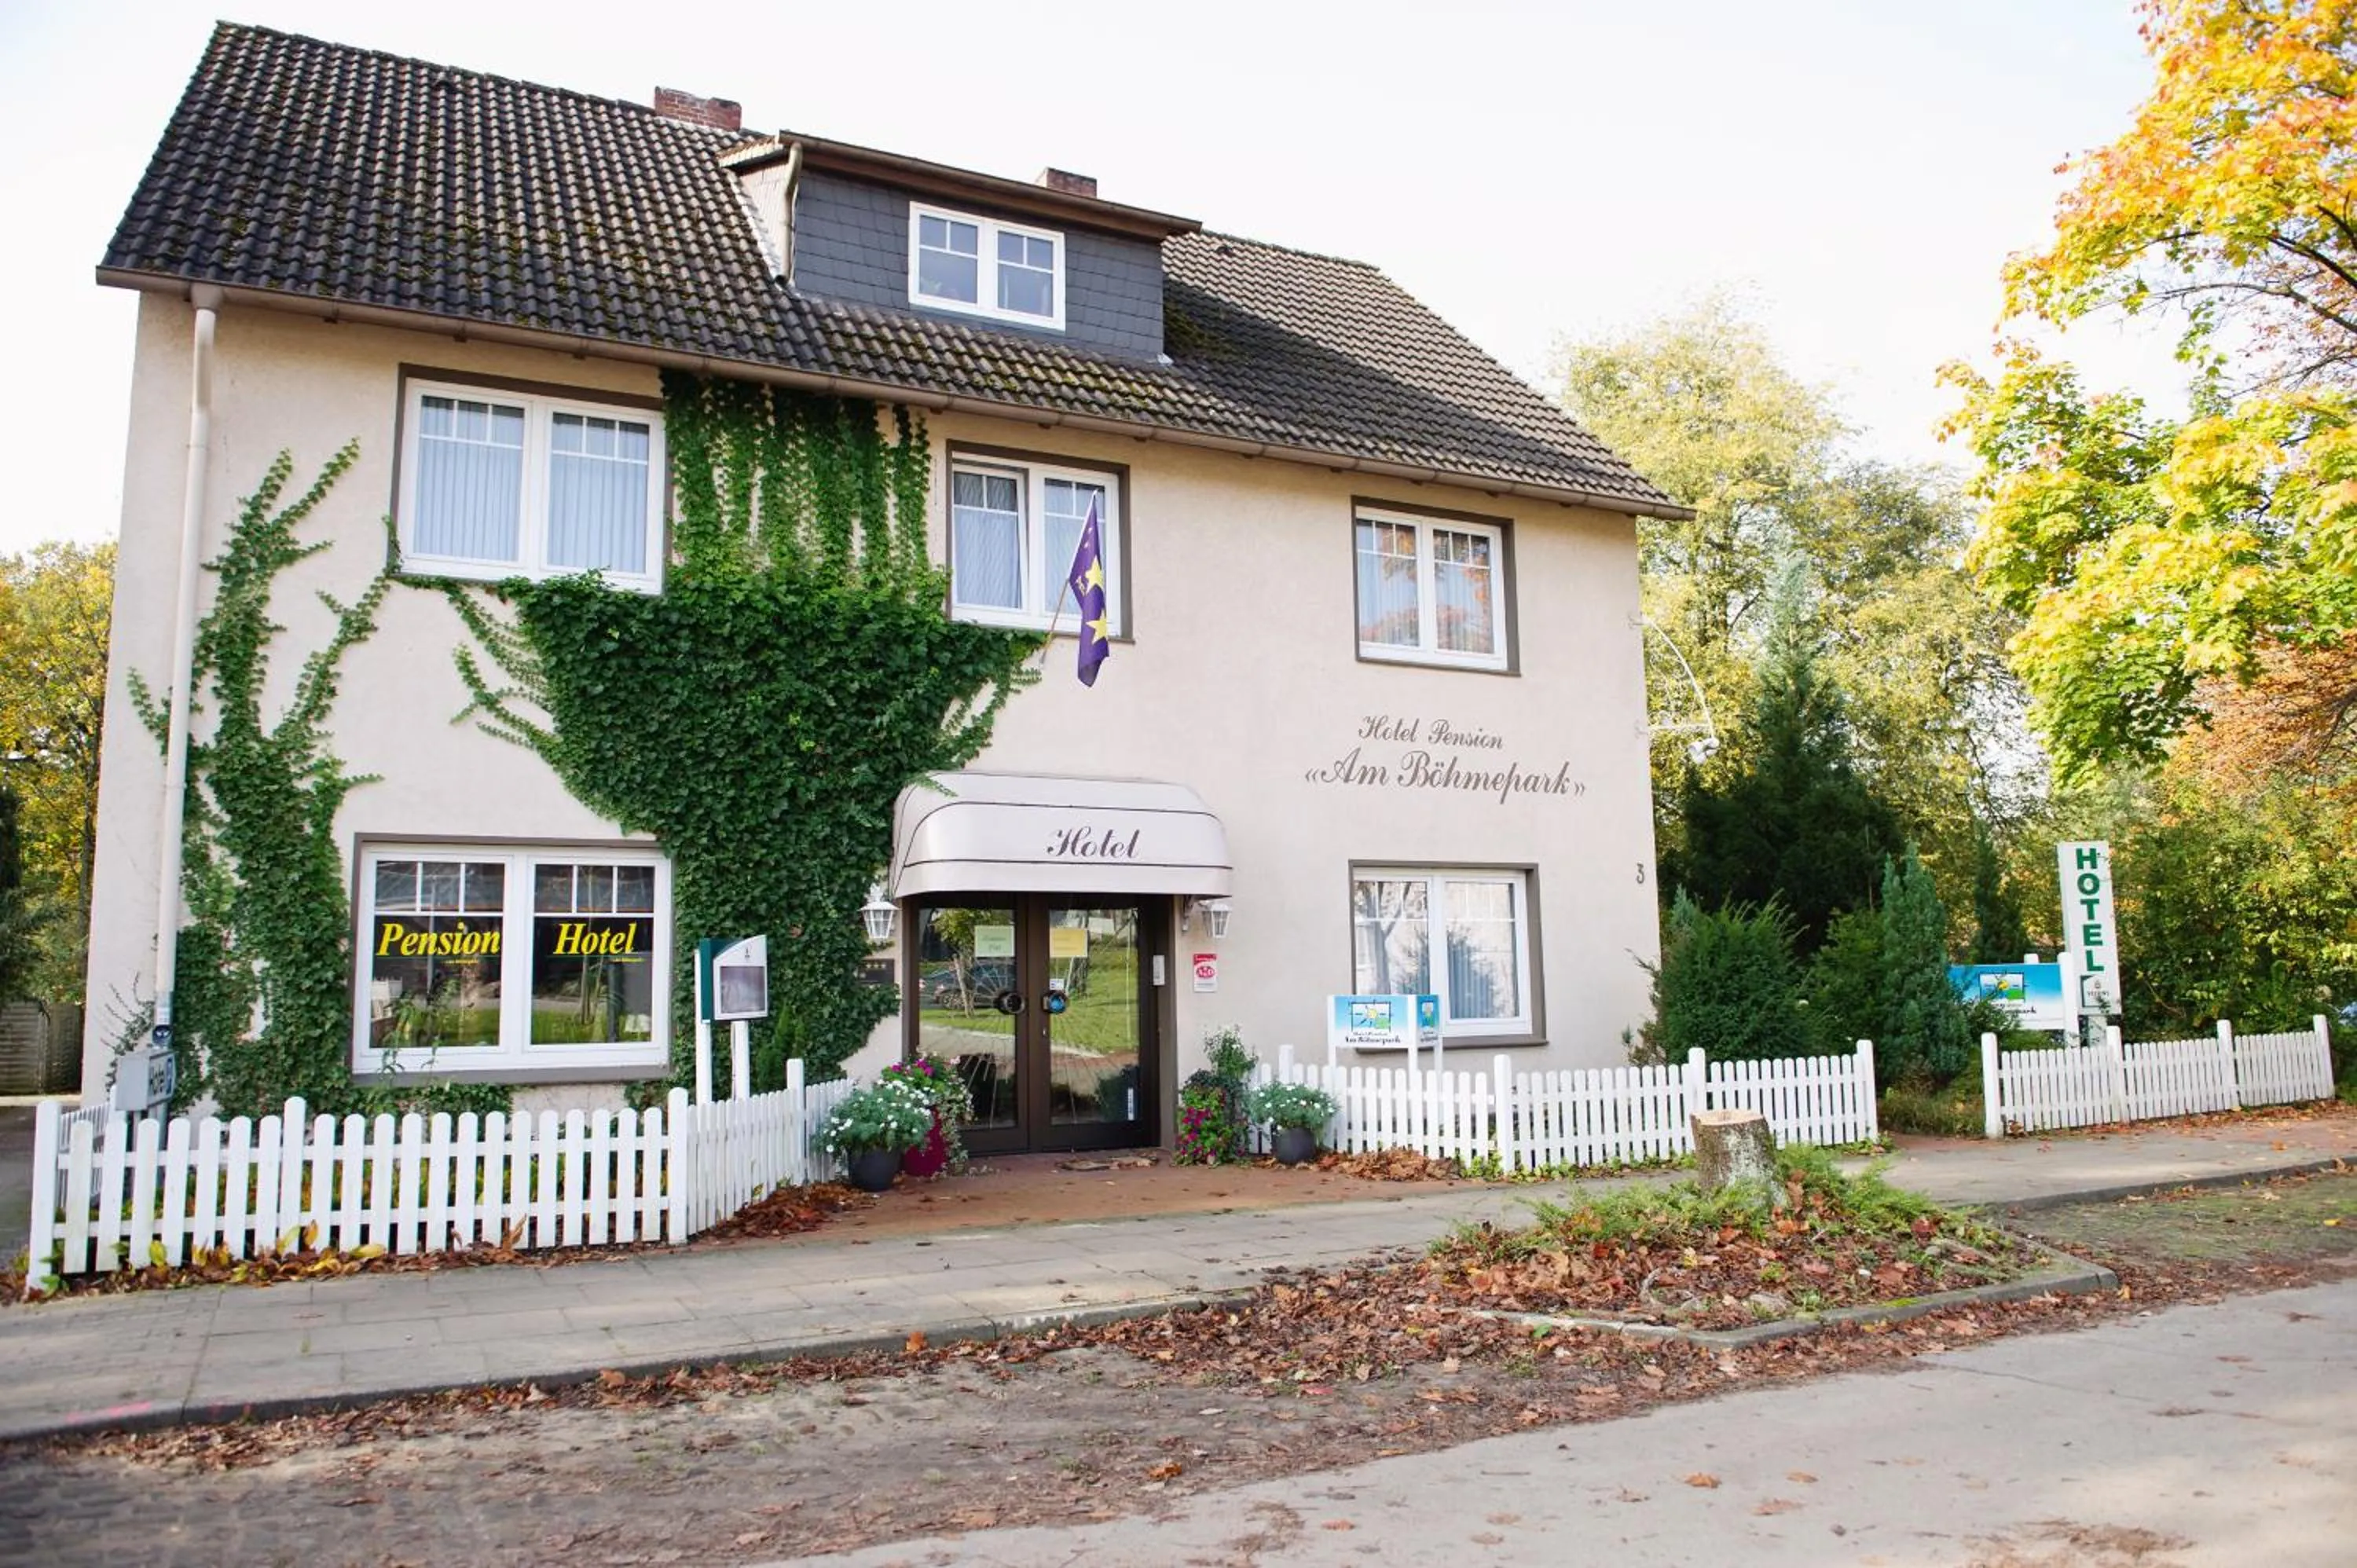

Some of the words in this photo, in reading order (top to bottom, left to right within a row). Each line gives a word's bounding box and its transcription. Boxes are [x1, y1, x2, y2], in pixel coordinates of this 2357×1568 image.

[1358, 716, 1419, 742] Hotel
[1428, 718, 1503, 749] Pension
[1046, 826, 1140, 858] Hotel
[1637, 863, 1645, 885] 3
[2076, 848, 2104, 971] HOTEL
[376, 921, 500, 956] Pension
[552, 922, 636, 955] Hotel
